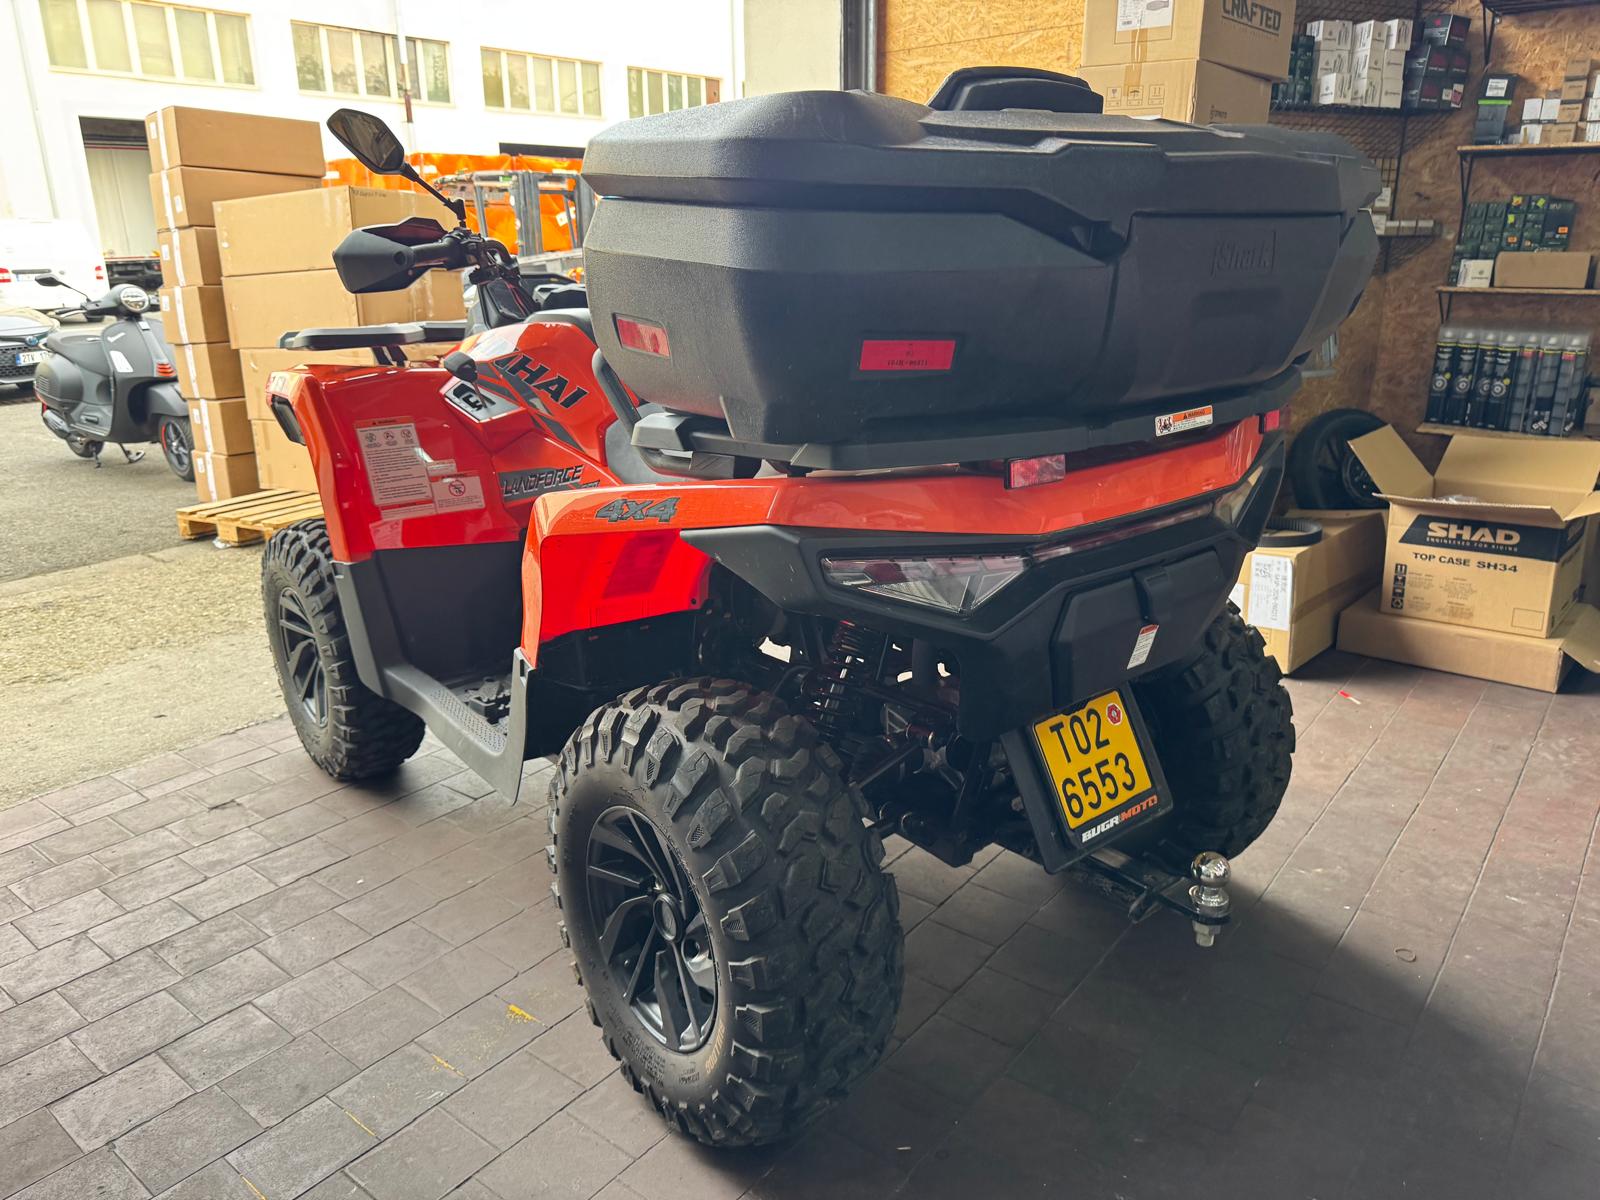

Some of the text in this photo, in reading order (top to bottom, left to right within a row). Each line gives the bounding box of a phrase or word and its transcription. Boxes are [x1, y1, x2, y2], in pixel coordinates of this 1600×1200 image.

[1222, 0, 1281, 31] CRAFTED
[503, 465, 584, 496] LANDFORCE
[1427, 522, 1520, 545] SHAD
[1412, 552, 1517, 572] TOP CASE SH34
[1049, 708, 1110, 764] T02
[1061, 752, 1136, 819] 6553
